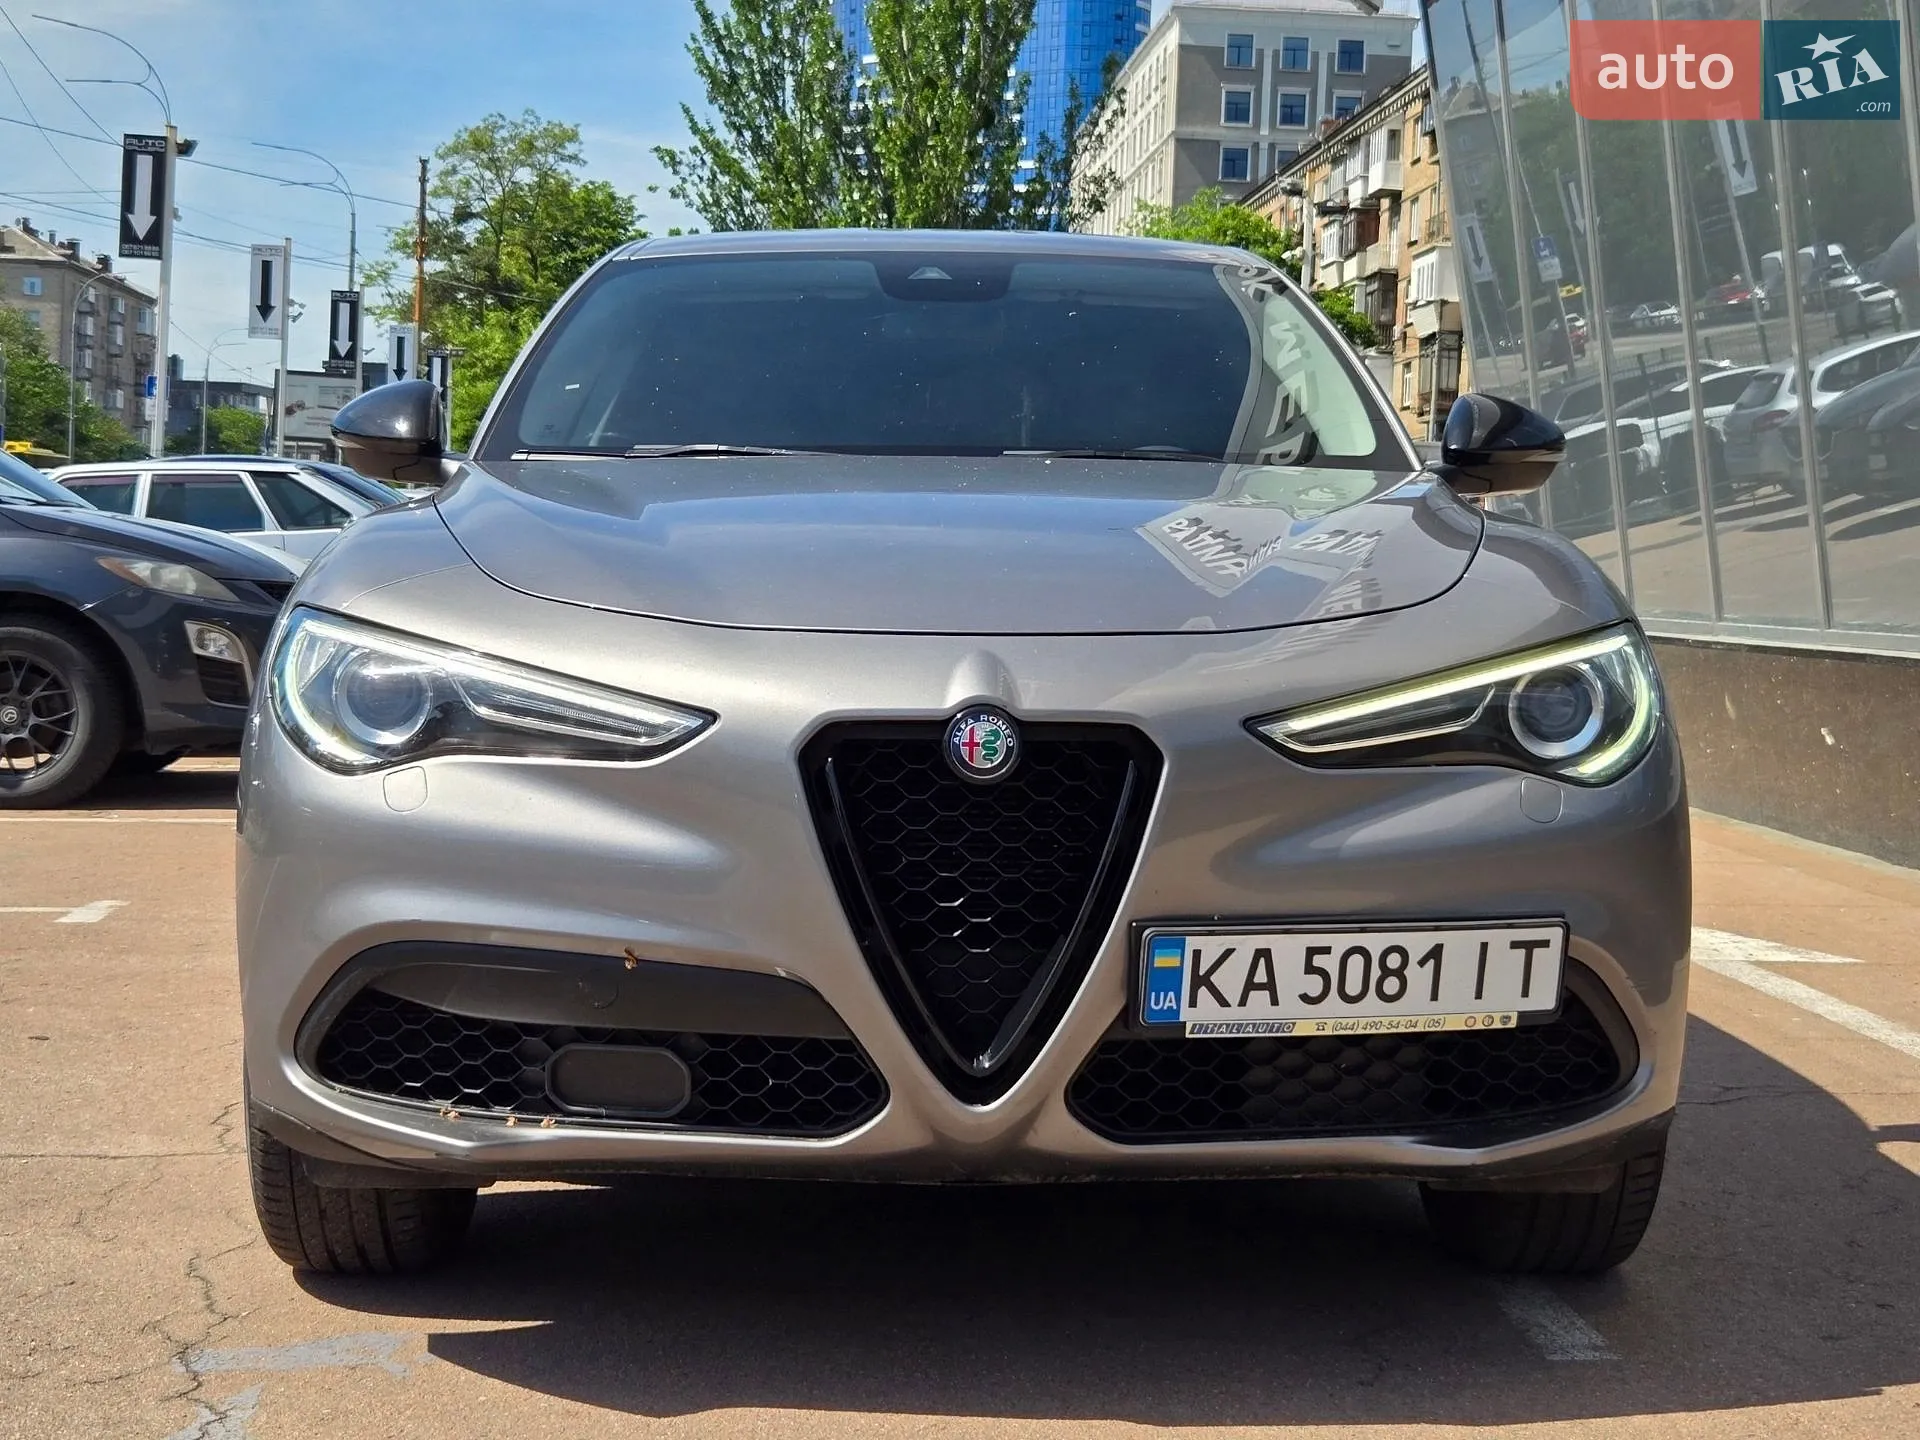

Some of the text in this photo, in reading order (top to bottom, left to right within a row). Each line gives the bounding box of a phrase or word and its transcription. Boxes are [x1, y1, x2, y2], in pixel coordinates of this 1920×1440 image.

[125, 138, 166, 147] AUTO
[953, 714, 1014, 747] ALFA ROMEO
[1150, 939, 1551, 1010] UA KA 5081 IT
[1361, 1019, 1418, 1031] 490-54-04
[1423, 1017, 1447, 1029] (05)
